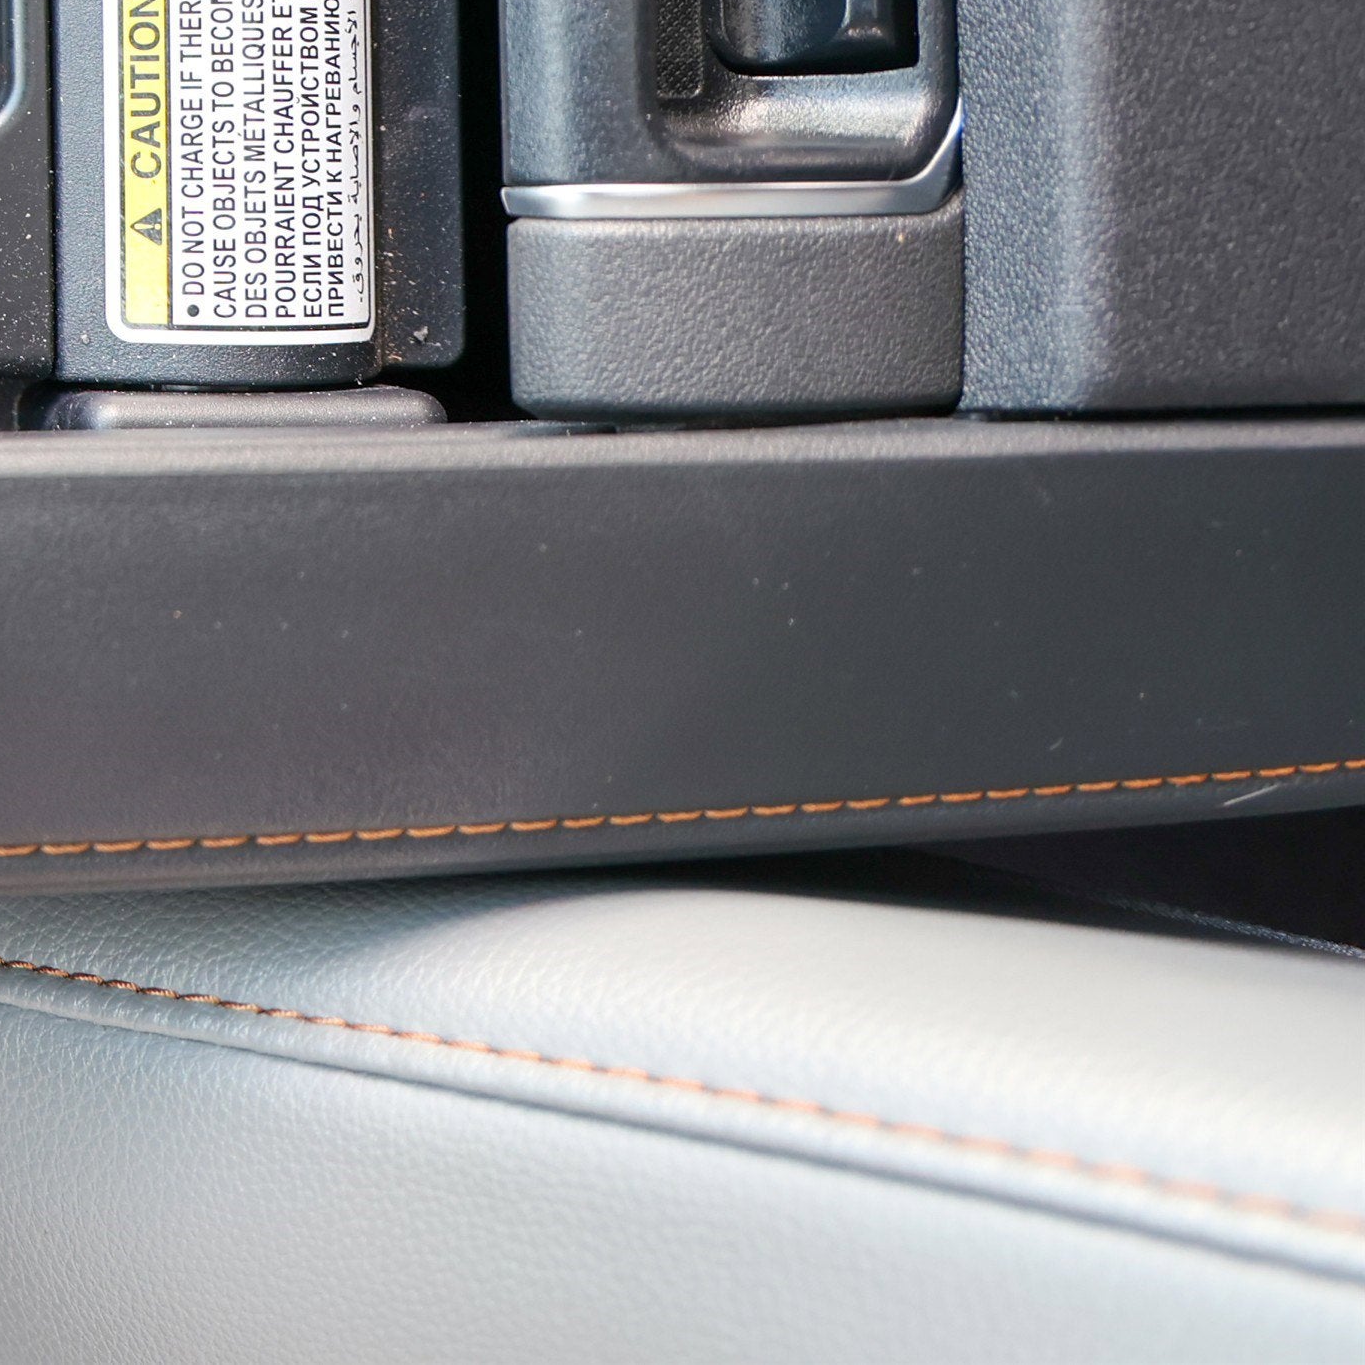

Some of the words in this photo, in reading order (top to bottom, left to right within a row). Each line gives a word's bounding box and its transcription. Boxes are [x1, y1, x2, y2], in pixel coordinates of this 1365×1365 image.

[179, 70, 203, 90] IF
[210, 80, 236, 113] TO
[270, 26, 295, 154] CHAUFFER
[294, 6, 322, 189] УСТРОЙСТВОМ
[179, 98, 205, 199] CHARGE
[210, 119, 237, 231] OBJECTS
[325, 169, 343, 184] К
[180, 205, 206, 254] NOT
[242, 170, 268, 264] OBJETS
[272, 160, 298, 318] POURRAIENT
[300, 194, 326, 246] ПОД
[181, 262, 206, 296] DO
[212, 238, 238, 319] CAUSE
[301, 254, 323, 318] ЕСЛИ
[325, 190, 345, 318] ПРИВЕСТИ
[244, 272, 269, 318] DES
